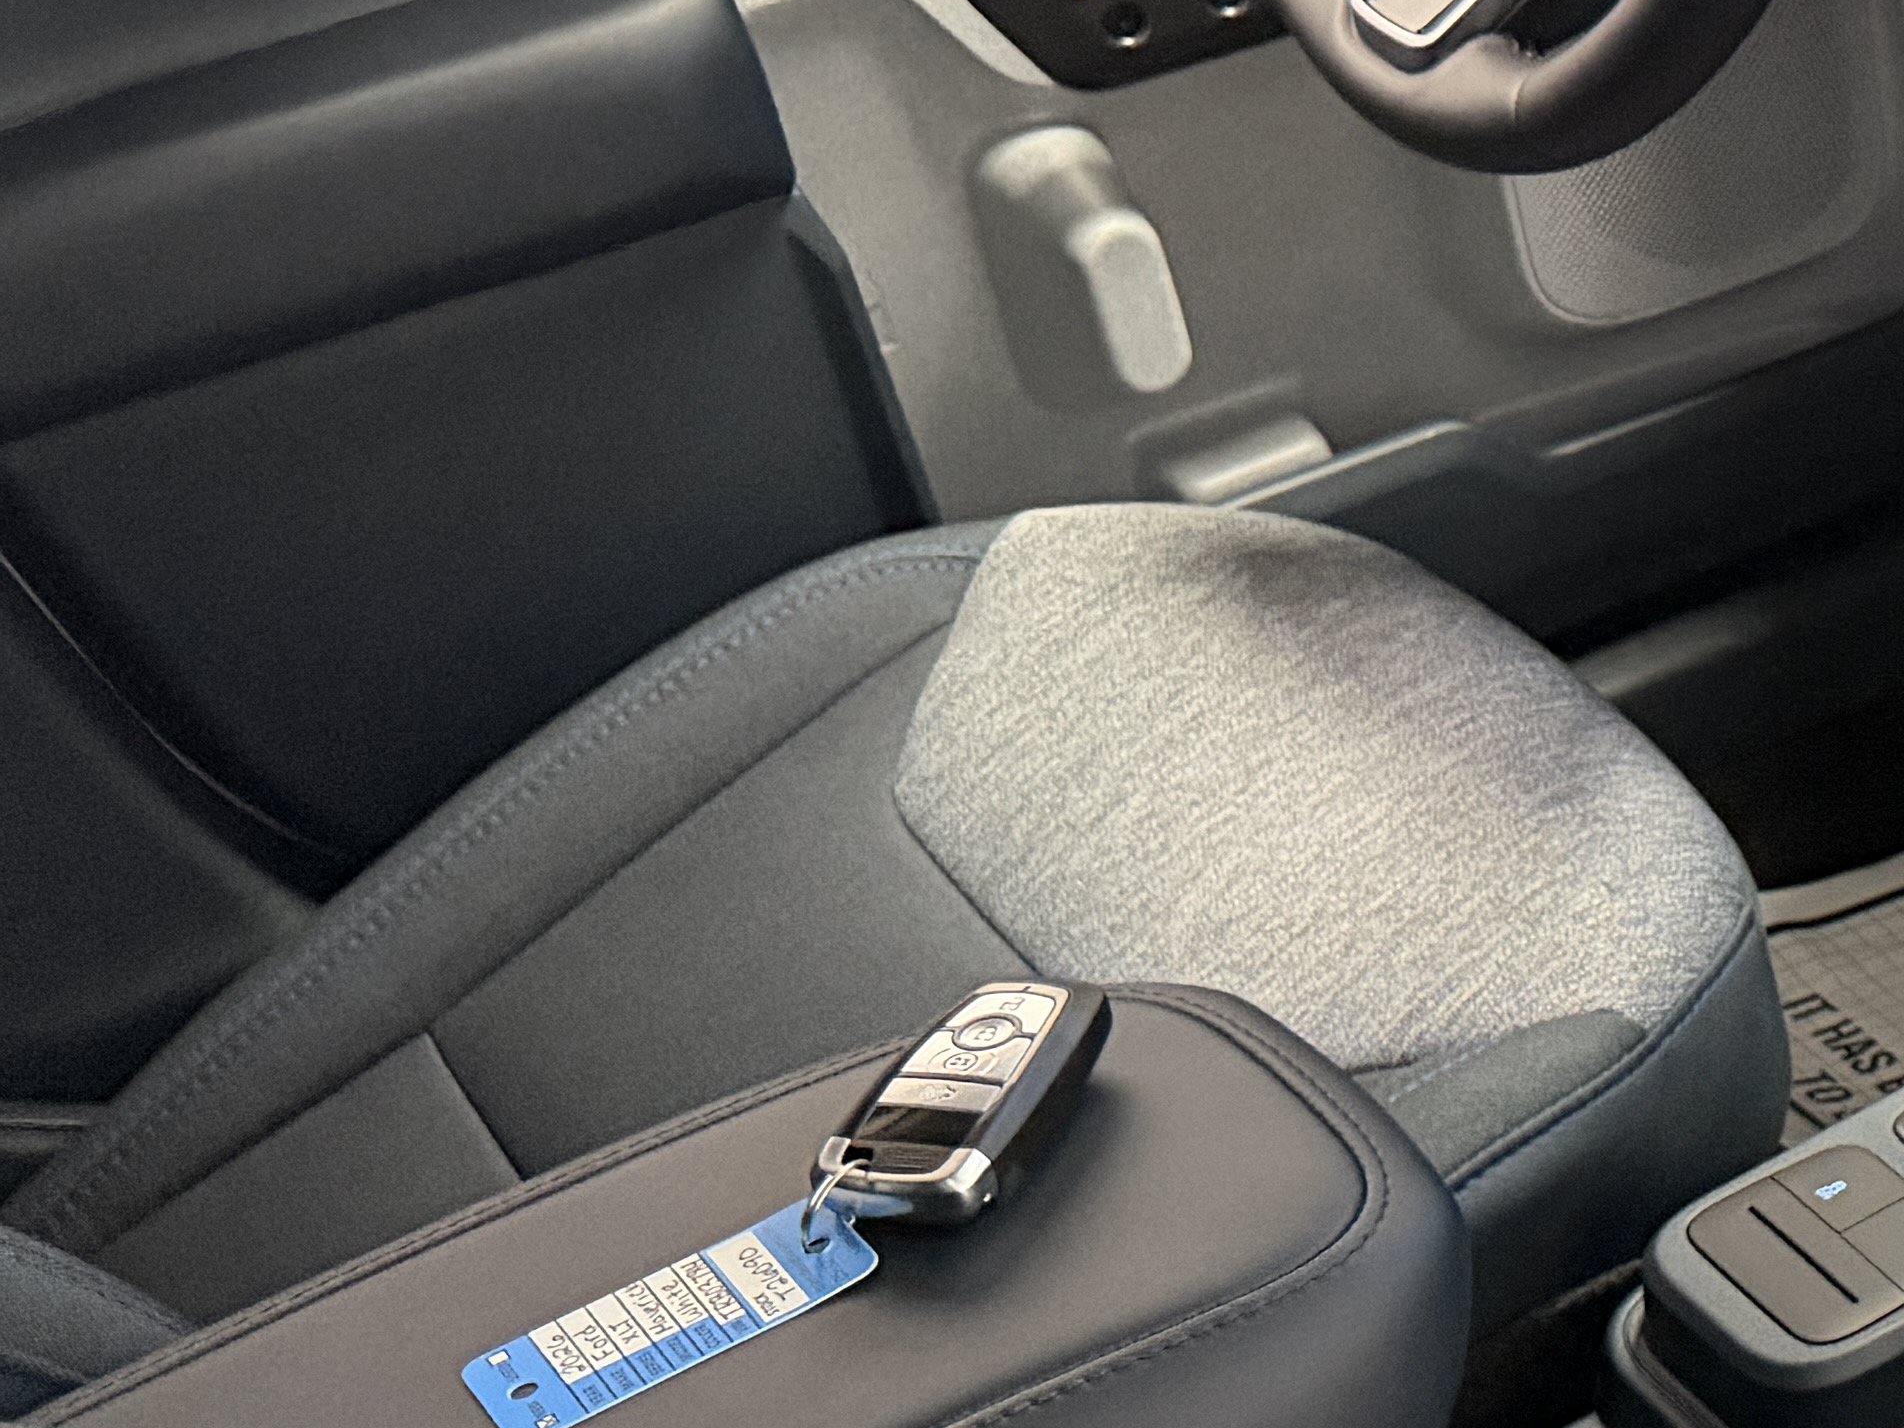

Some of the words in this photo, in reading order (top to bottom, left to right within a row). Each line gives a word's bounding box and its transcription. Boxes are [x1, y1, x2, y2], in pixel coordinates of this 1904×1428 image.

[1782, 993, 1839, 1022] IT
[1810, 1018, 1898, 1074] HAS
[1792, 1069, 1853, 1104] TO
[738, 1247, 795, 1301] T26090
[661, 1279, 705, 1322] White
[578, 1324, 615, 1362] Ford
[609, 1320, 639, 1343] XLT
[550, 1334, 587, 1374] 2026
